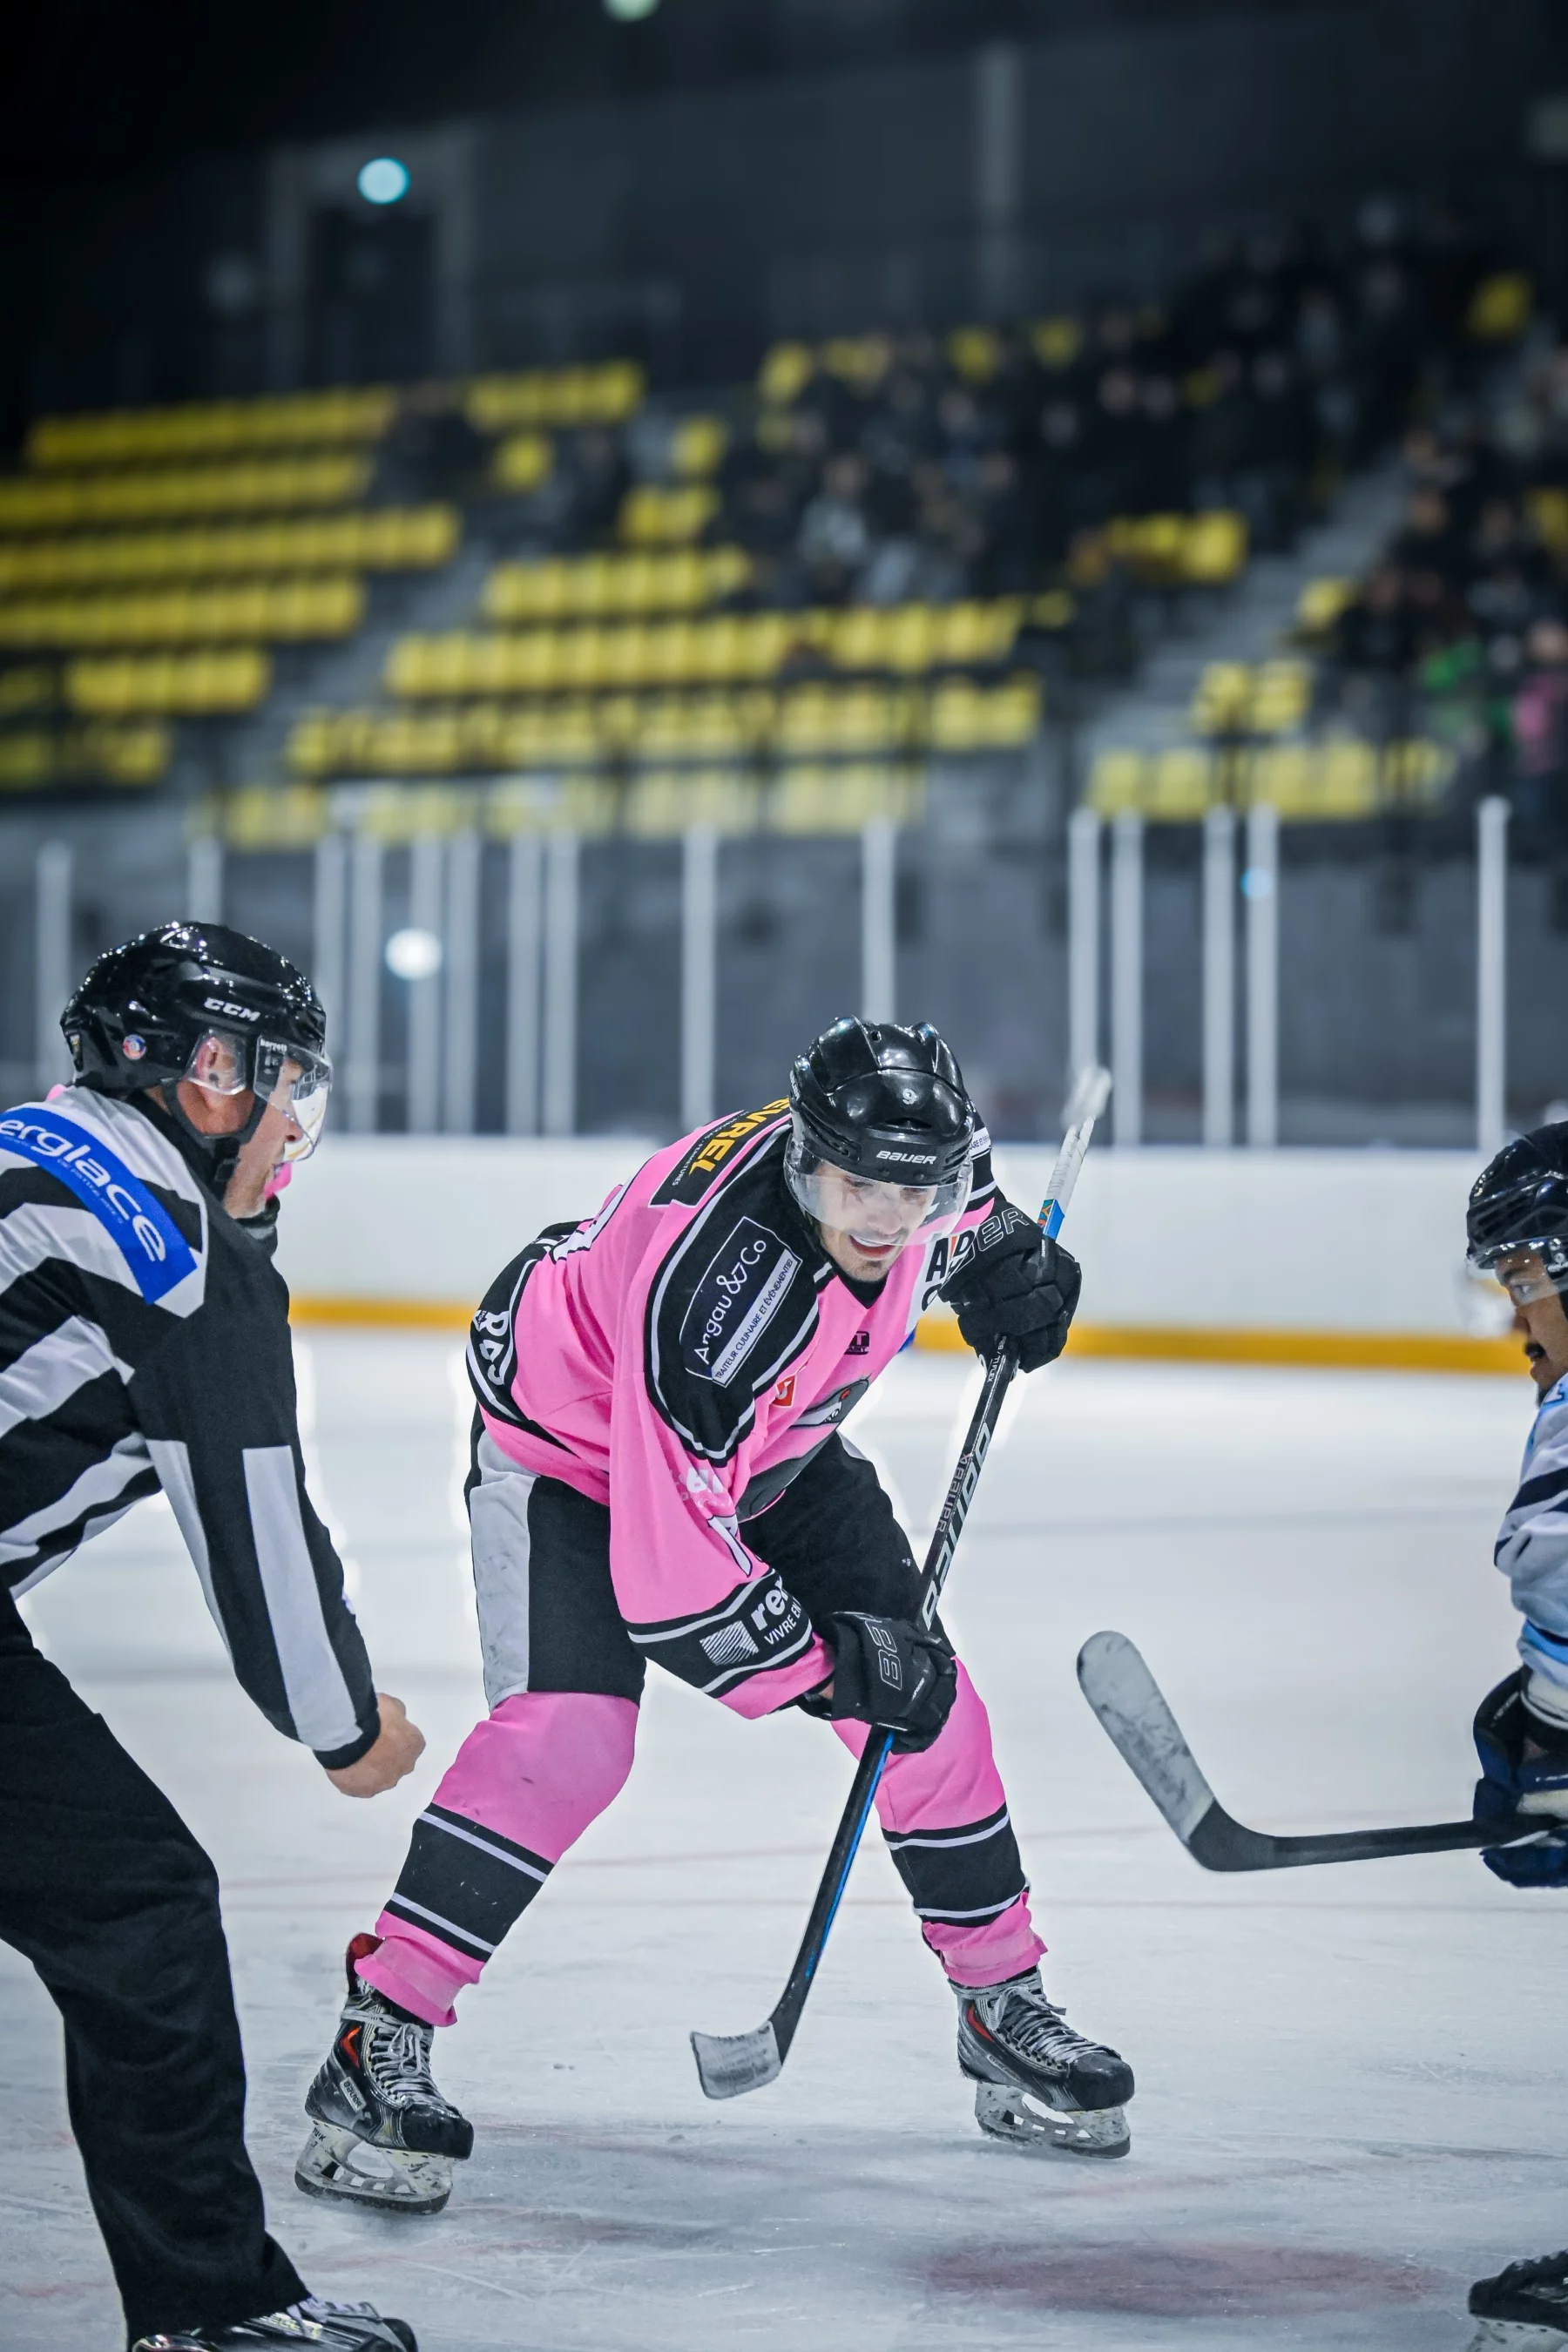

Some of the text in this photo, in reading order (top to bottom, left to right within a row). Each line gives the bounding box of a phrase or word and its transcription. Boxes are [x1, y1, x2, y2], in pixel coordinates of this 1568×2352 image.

[204, 997, 260, 1021] CCM
[902, 1088, 916, 1105] 9
[876, 1150, 936, 1166] BAUER
[714, 1352, 738, 1379] TRAITEUR
[735, 1314, 763, 1352] CULINAIRE
[758, 1302, 768, 1315] ET
[986, 1363, 997, 1383] FLEX
[936, 1466, 965, 1533] BAUER
[764, 1615, 797, 1646] VIVRE
